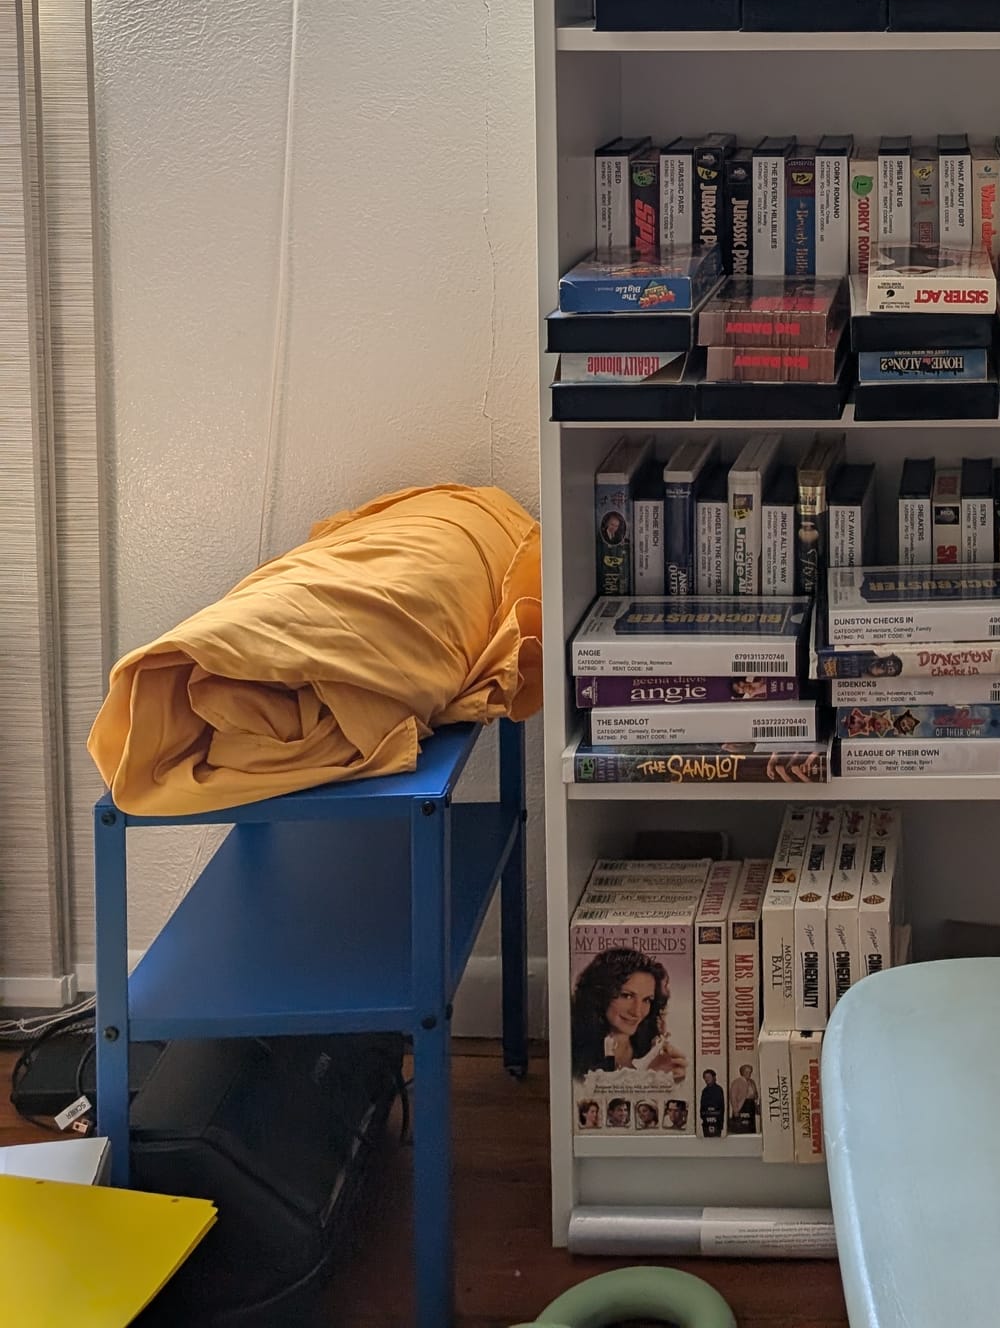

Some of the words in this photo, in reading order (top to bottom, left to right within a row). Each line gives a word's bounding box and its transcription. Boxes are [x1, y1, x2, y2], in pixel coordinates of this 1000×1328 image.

[700, 183, 718, 234] JURASSIC
[732, 197, 749, 248] JURASSIC
[914, 289, 941, 304] ACT
[943, 289, 989, 304] SISTER
[587, 356, 622, 377] blonde
[931, 356, 964, 370] HOME
[917, 504, 925, 542] SNEAKERS
[734, 528, 746, 577] Jingle
[626, 612, 782, 623] BLOCKBUSTER
[834, 617, 872, 626] DUNSTON
[873, 617, 905, 625] CHECKS
[905, 616, 914, 624] IN
[577, 649, 601, 657] ANGIE
[917, 649, 993, 667] DUNSTON
[630, 684, 707, 703] angie
[837, 680, 877, 688] SIDEKICKS
[613, 718, 650, 726] SANDLOT
[897, 749, 919, 757] THEIR
[637, 761, 666, 776] THE
[667, 754, 746, 783] SANDLOT
[575, 927, 615, 935] JULIA
[624, 927, 687, 935] ROBERTS
[575, 936, 597, 951] MY
[599, 937, 628, 951] BEST
[631, 936, 687, 953] FRIEND'S
[700, 958, 721, 986] MRS.
[734, 953, 754, 982] MRS.
[771, 954, 782, 991] BALL
[784, 944, 793, 999] MONSTER'S
[804, 951, 819, 1009] CONGENIALITY
[700, 990, 721, 1056] DOUBTFIRE
[734, 986, 755, 1052] DOUBTFIRE
[768, 1086, 780, 1122] BALL
[781, 1076, 790, 1131] MONSTER'S
